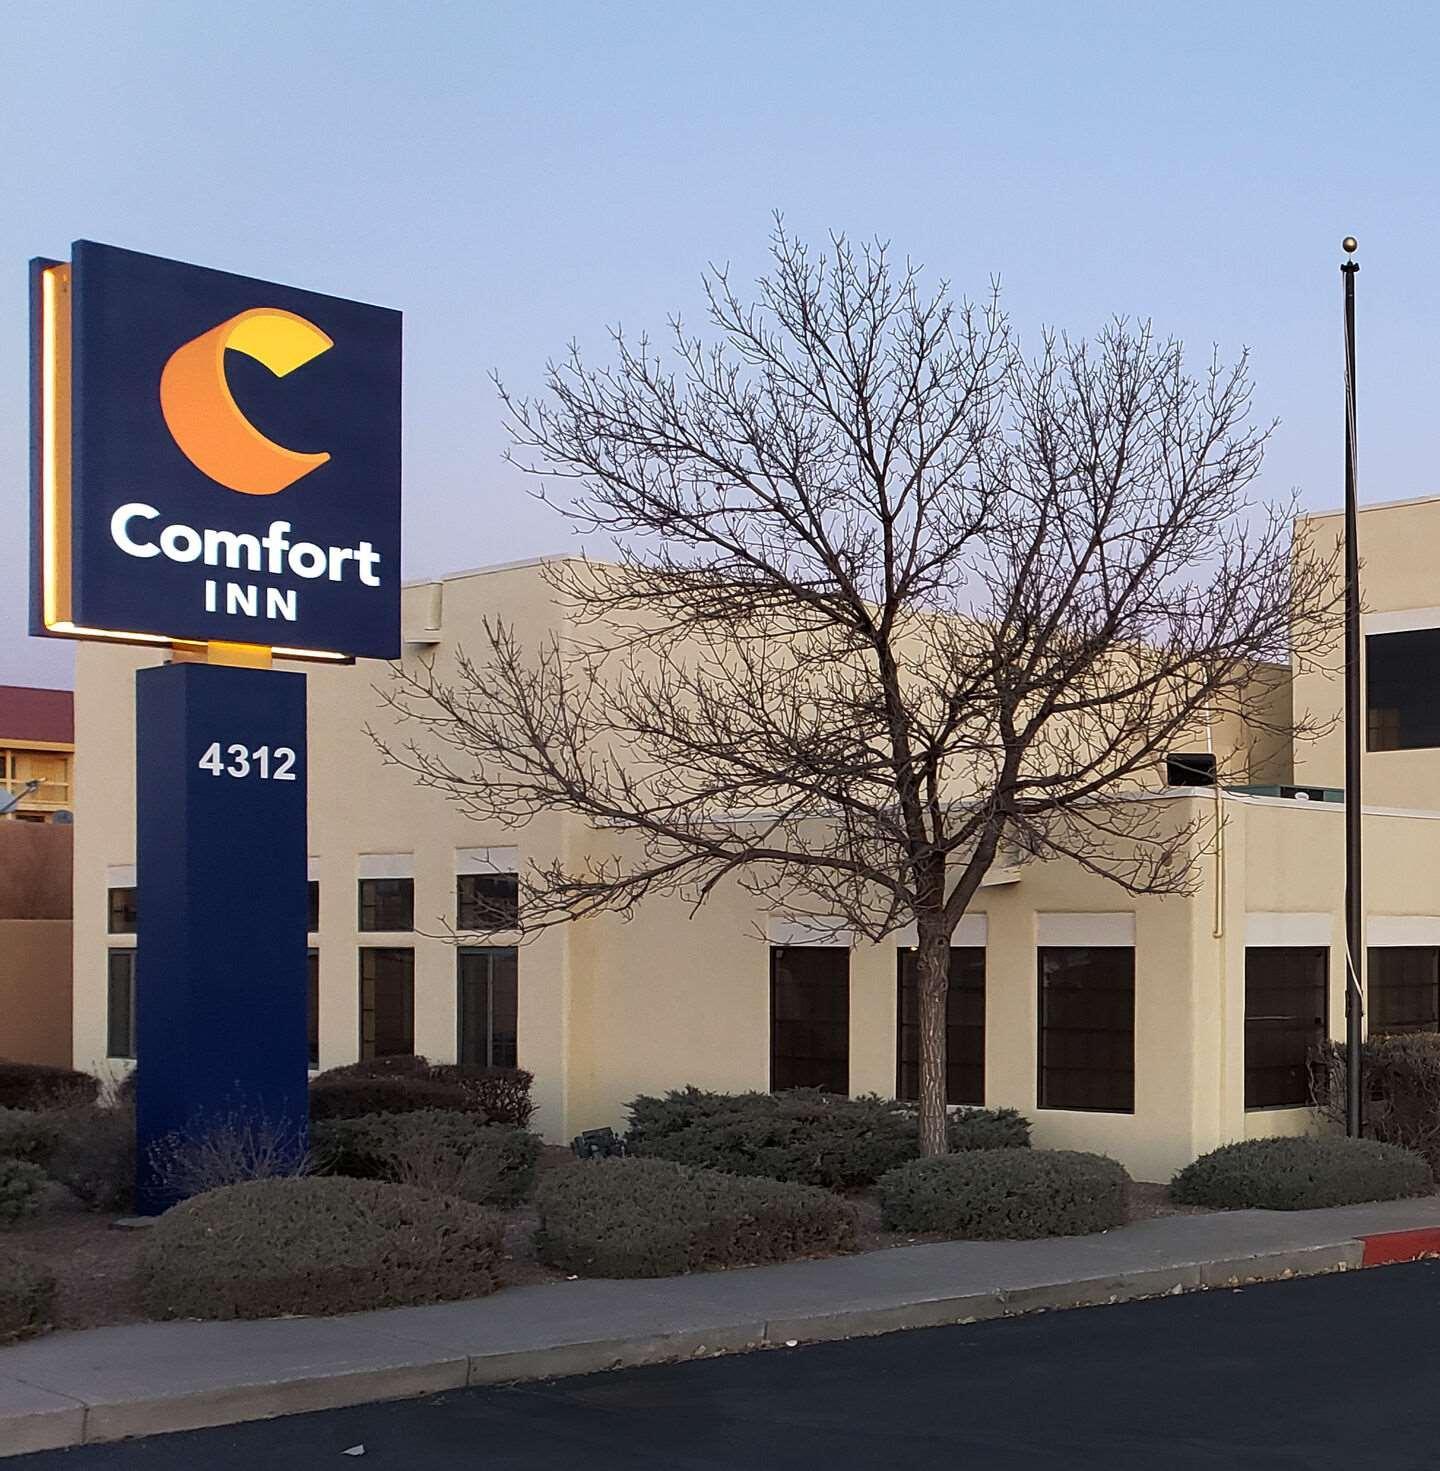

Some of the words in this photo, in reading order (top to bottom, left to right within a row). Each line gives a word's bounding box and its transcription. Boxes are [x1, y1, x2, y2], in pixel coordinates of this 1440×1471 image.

[110, 502, 381, 587] Comfort
[205, 579, 297, 621] INN
[198, 742, 297, 781] 4312
